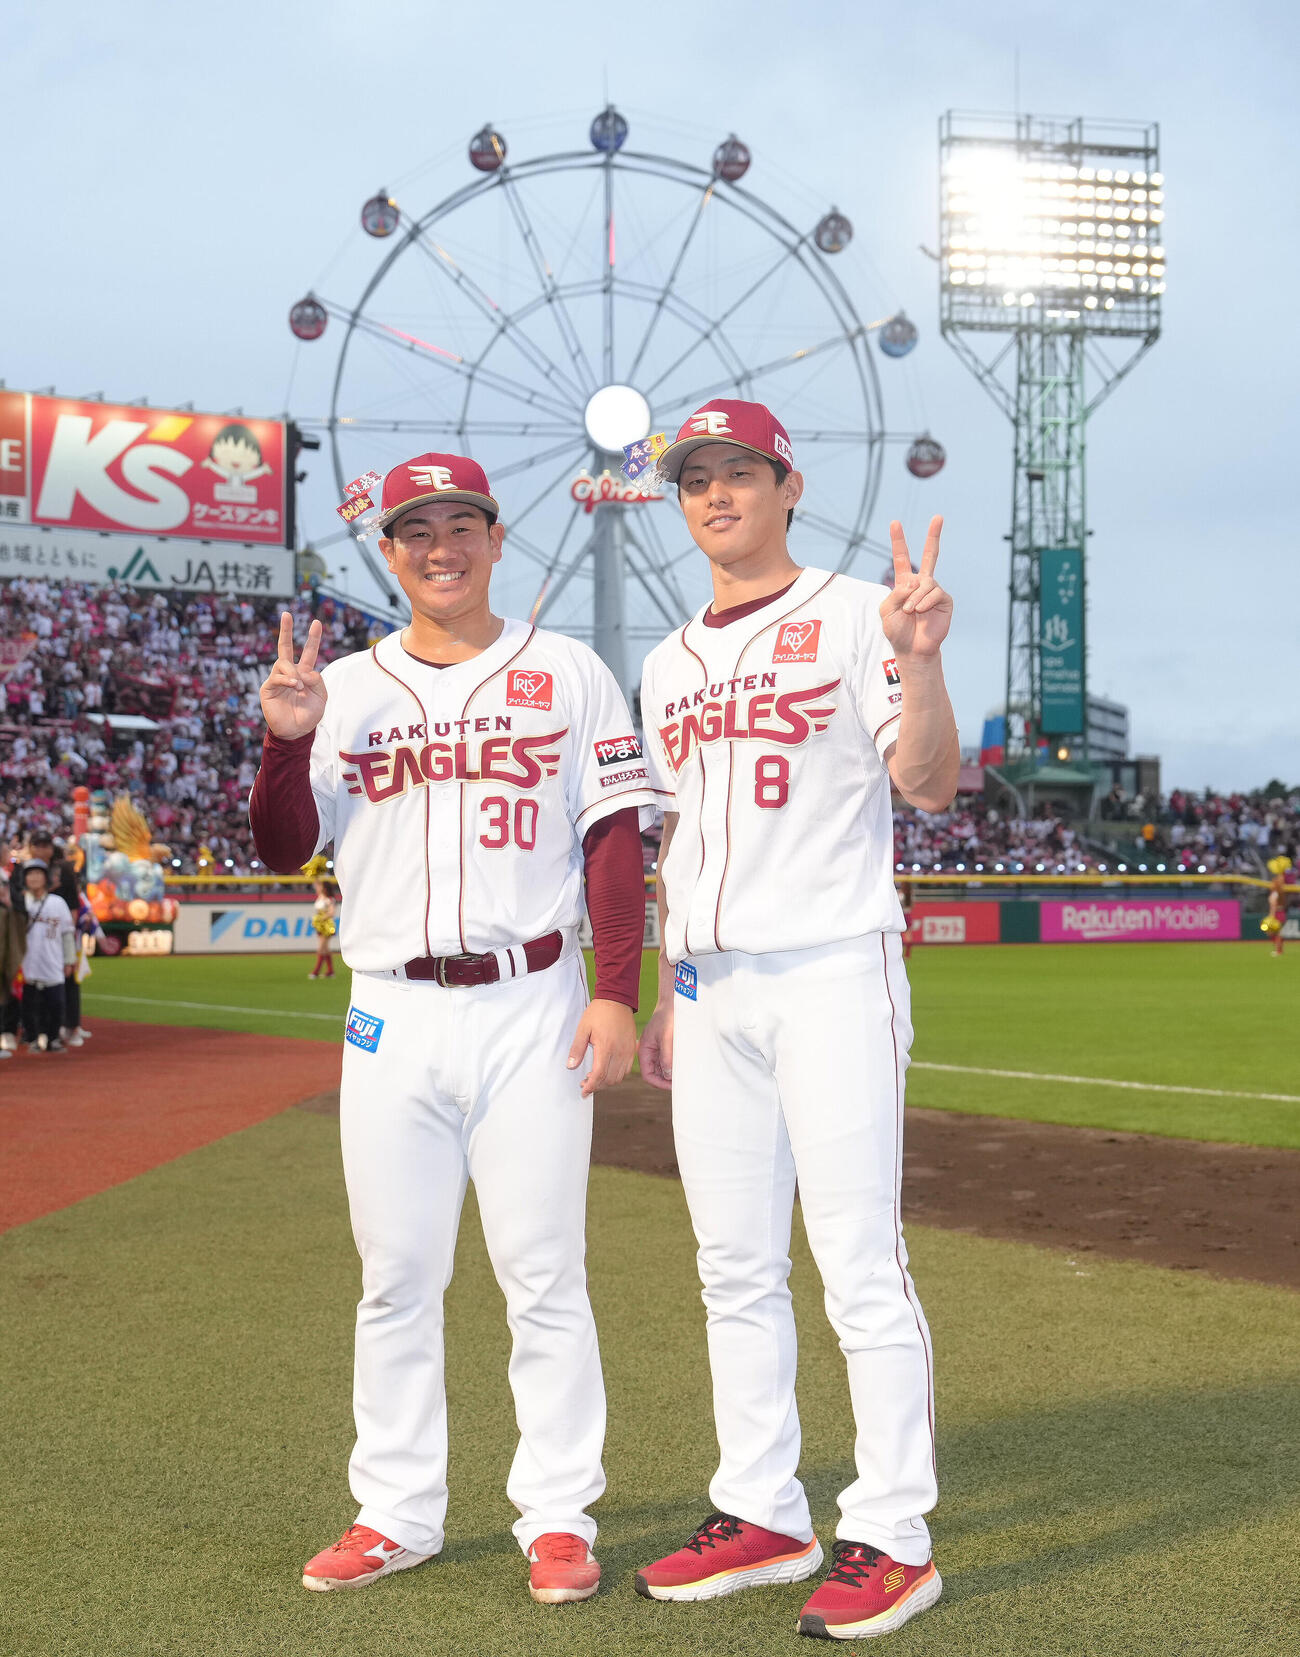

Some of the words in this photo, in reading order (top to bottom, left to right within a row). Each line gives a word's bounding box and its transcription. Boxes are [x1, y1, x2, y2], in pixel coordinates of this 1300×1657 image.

[171, 560, 273, 590] JA共済
[665, 672, 777, 720] RAKUTEN
[368, 715, 512, 747] RAKUTEN
[658, 678, 841, 776] EAGLES
[339, 727, 569, 805] EAGLES
[754, 754, 790, 809] 8
[478, 795, 540, 851] 30
[1062, 904, 1152, 938] Rakuten
[1154, 905, 1220, 930] Mobile
[349, 1010, 380, 1037] Fuji
